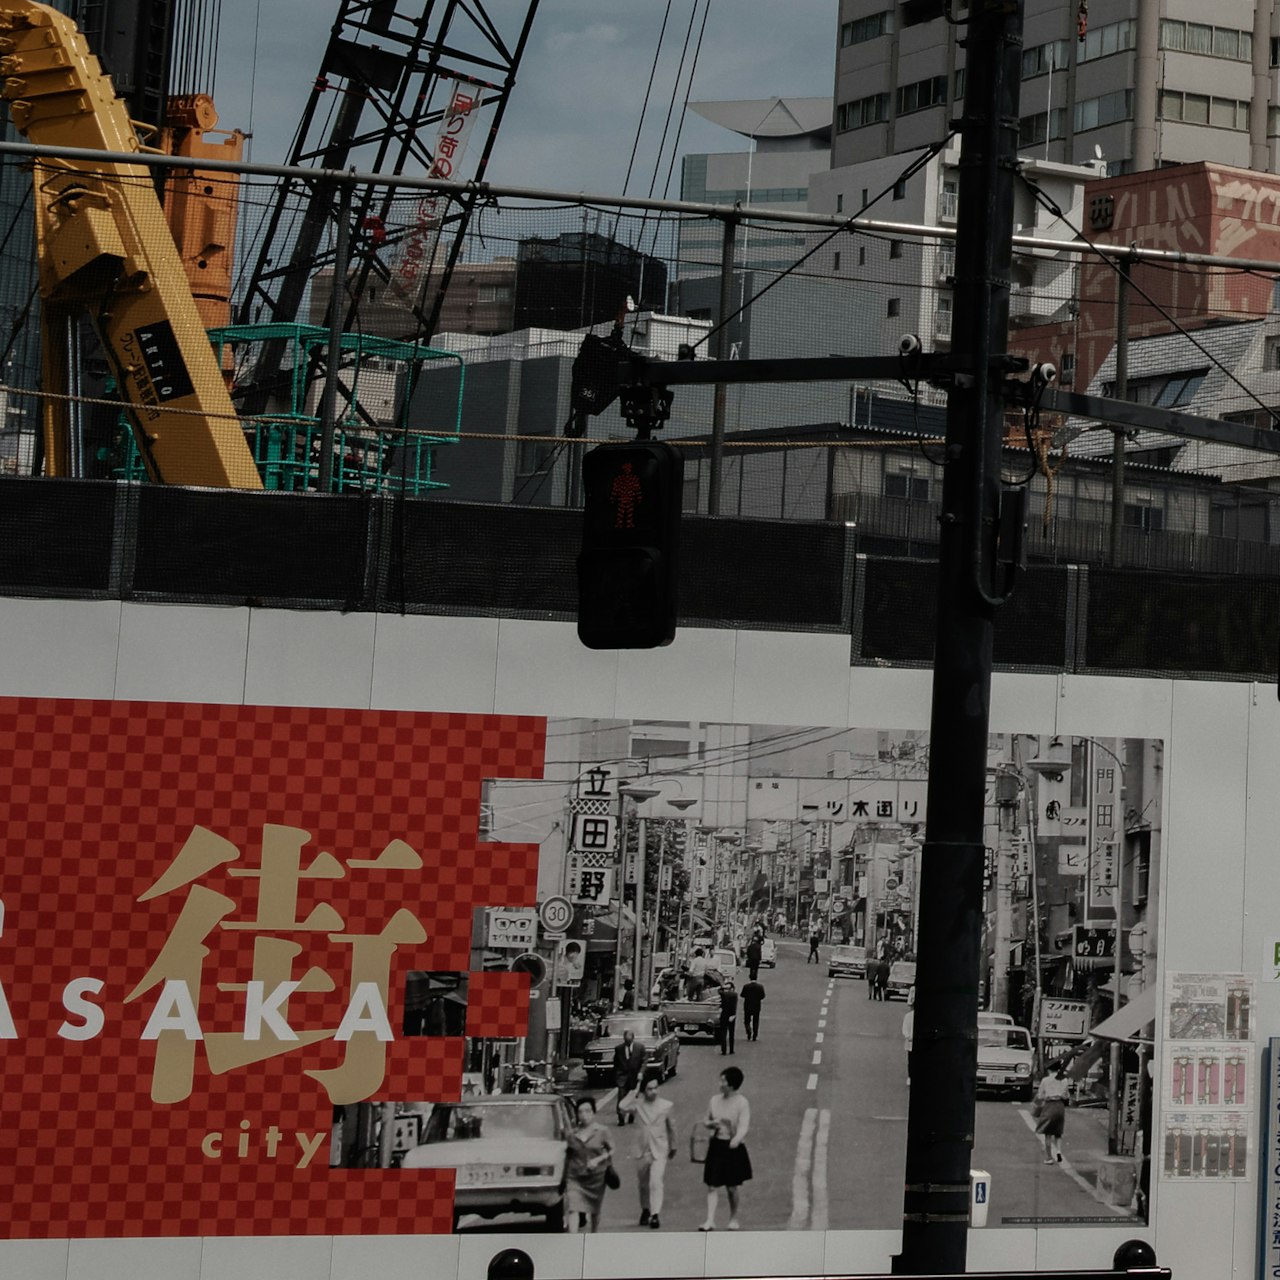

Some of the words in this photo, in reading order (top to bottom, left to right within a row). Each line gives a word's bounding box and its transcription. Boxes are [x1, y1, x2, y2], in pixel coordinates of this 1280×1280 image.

[140, 332, 173, 395] AKTIO
[802, 800, 918, 818] 一ツ木通り
[548, 905, 566, 921] 30
[122, 823, 428, 1105] 街
[201, 1119, 328, 1169] city
